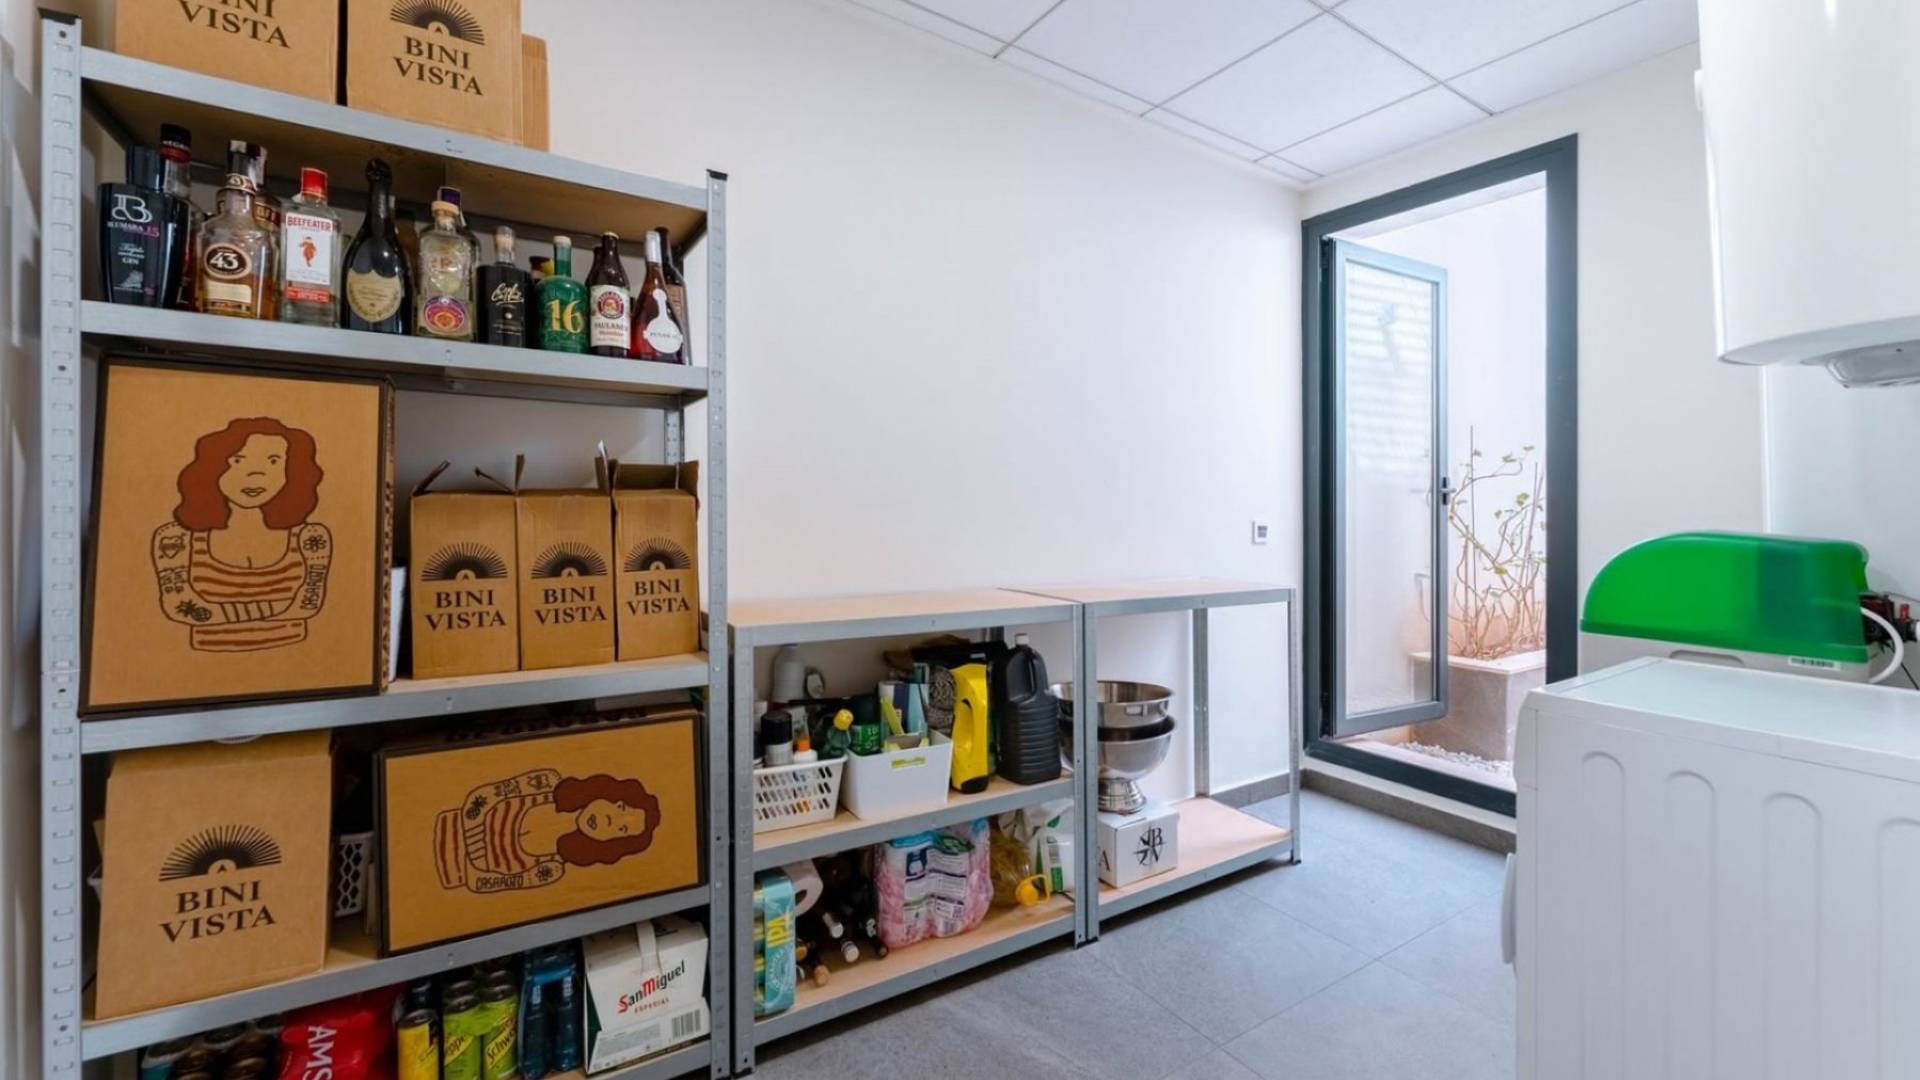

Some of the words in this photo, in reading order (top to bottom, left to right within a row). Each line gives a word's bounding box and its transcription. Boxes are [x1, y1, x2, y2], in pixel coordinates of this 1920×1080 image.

[177, 0, 290, 48] VISTA
[404, 36, 470, 69] BINI
[394, 57, 483, 95] VISTA
[287, 216, 332, 231] BEEFEATER
[210, 252, 239, 270] 43
[547, 299, 585, 334] 16
[543, 586, 596, 605] BINI
[634, 578, 681, 596] BINI
[436, 589, 494, 609] BINI
[627, 597, 691, 615] VISTA
[425, 611, 507, 631] VISTA
[535, 606, 607, 625] VISTA
[176, 880, 261, 914] BINI
[160, 905, 276, 943] VISTA
[766, 913, 791, 948] IPA
